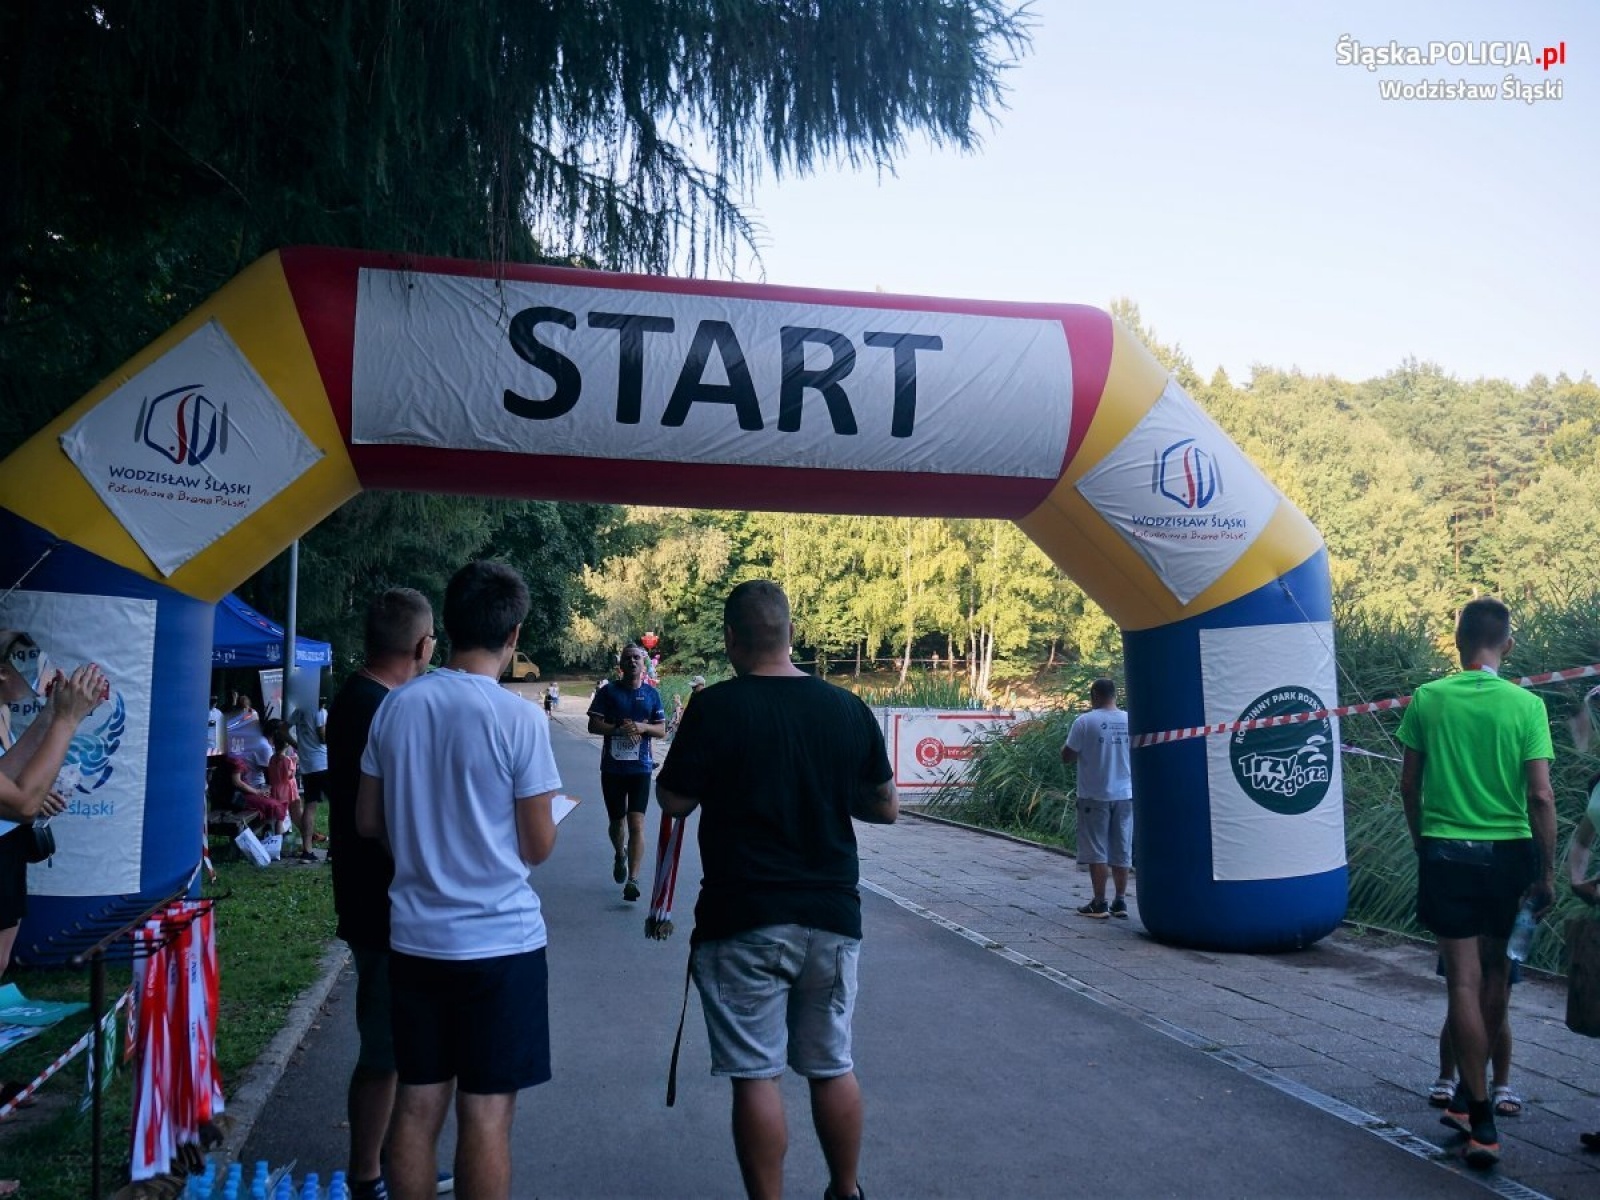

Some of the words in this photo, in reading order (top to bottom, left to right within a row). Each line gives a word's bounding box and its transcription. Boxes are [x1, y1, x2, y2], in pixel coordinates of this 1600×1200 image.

[503, 306, 943, 438] START
[109, 464, 200, 488] WODZISŁAW
[205, 475, 251, 496] ŚLĄSKI
[178, 490, 213, 505] Brama
[1132, 515, 1208, 528] WODZISŁAW
[1211, 514, 1247, 530] ŚLĄSKI
[1235, 698, 1271, 745] ROZINNY
[1272, 692, 1297, 704] PARK
[1239, 752, 1299, 779] Trzy
[1252, 764, 1328, 796] Wzgórza
